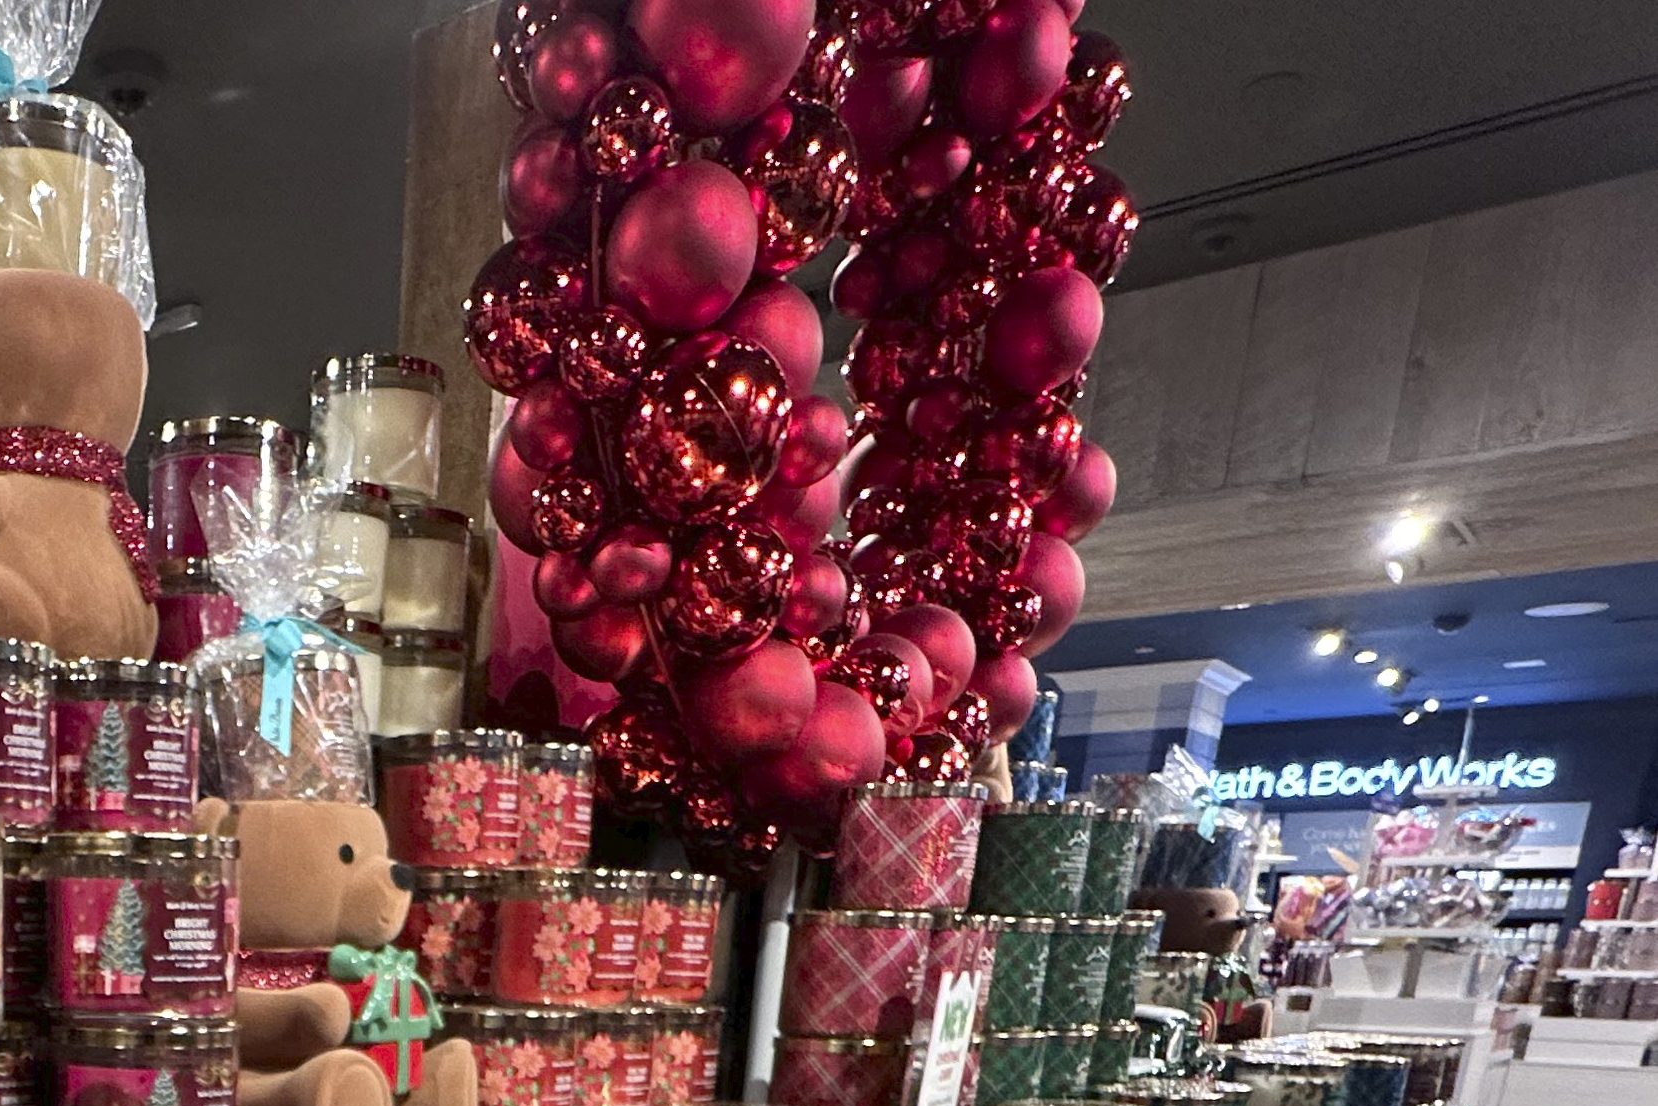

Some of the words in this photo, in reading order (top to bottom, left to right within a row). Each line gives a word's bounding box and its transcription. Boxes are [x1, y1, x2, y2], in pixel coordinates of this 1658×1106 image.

[1210, 766, 1276, 800] ath
[1276, 762, 1308, 798] &
[1309, 759, 1417, 796] Body
[1419, 752, 1556, 788] Works
